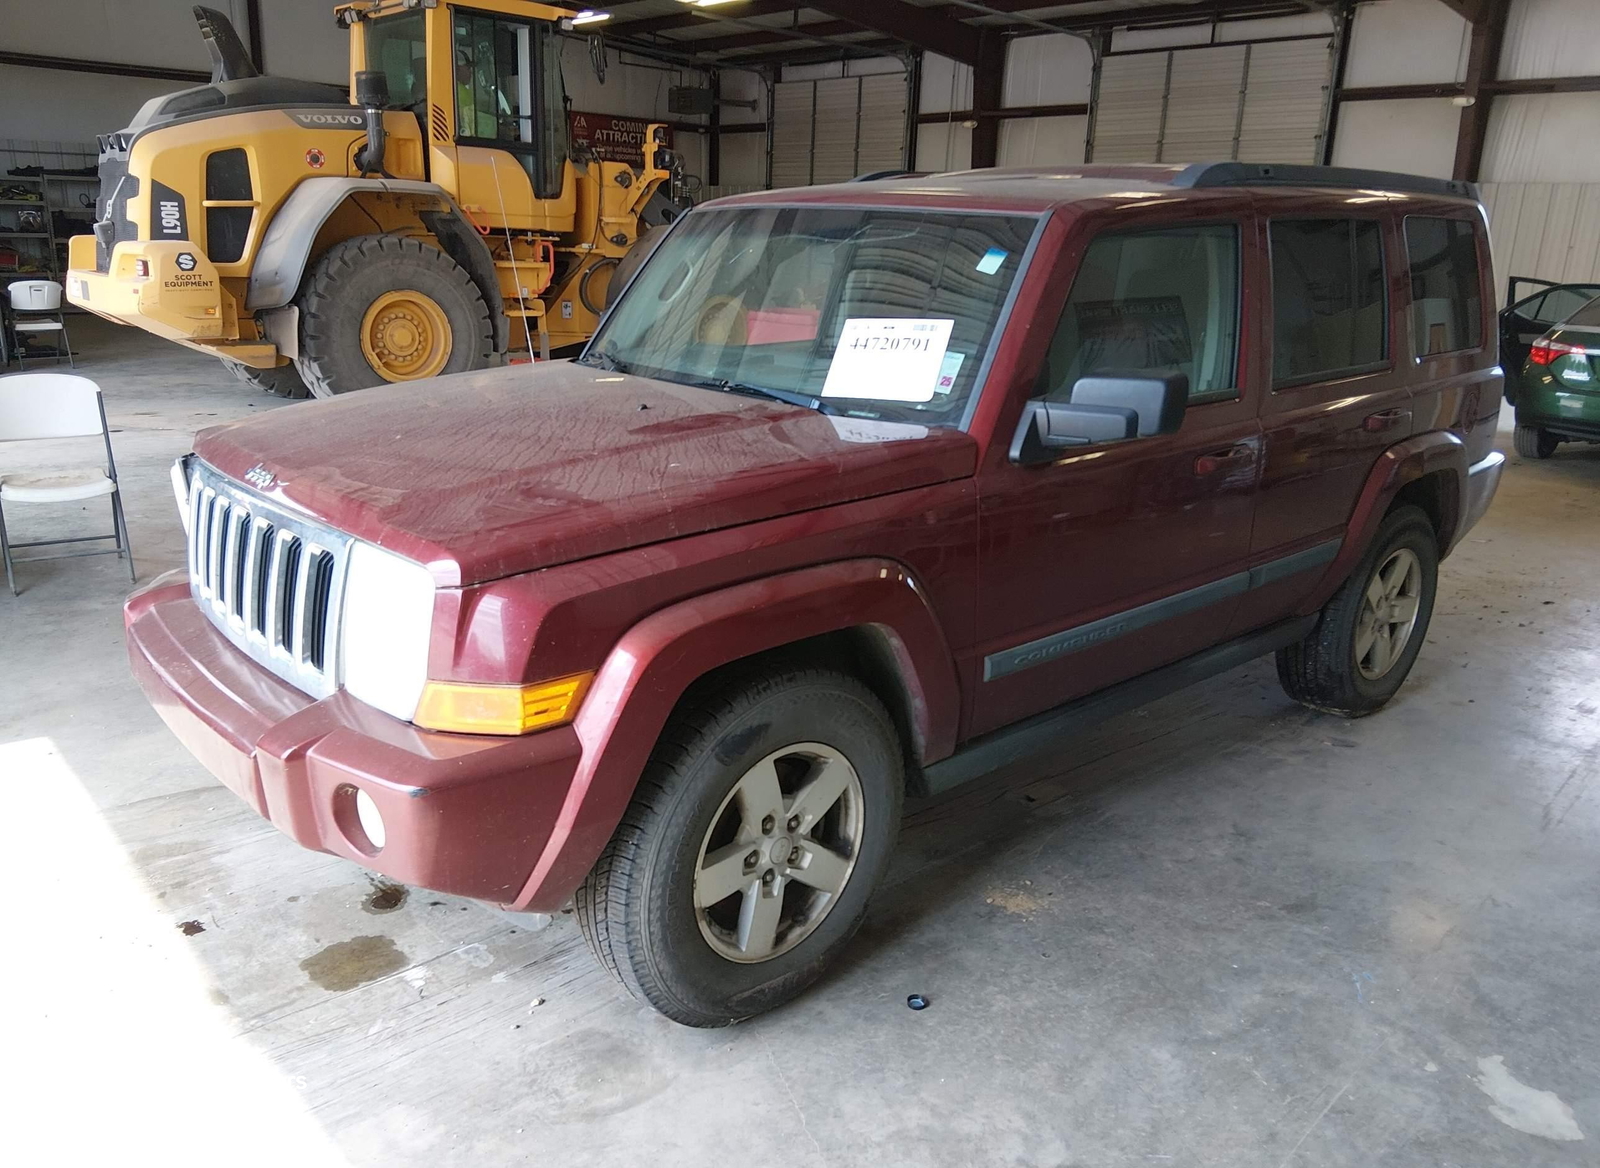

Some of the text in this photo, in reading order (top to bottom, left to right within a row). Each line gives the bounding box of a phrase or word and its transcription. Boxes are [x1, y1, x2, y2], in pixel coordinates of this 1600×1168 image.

[297, 113, 363, 126] VOLVO
[611, 119, 648, 134] COMIN
[160, 201, 182, 234] L90H
[164, 280, 214, 288] EQUIPMENT
[174, 273, 203, 281] SCOTT
[850, 337, 931, 352] 44720791
